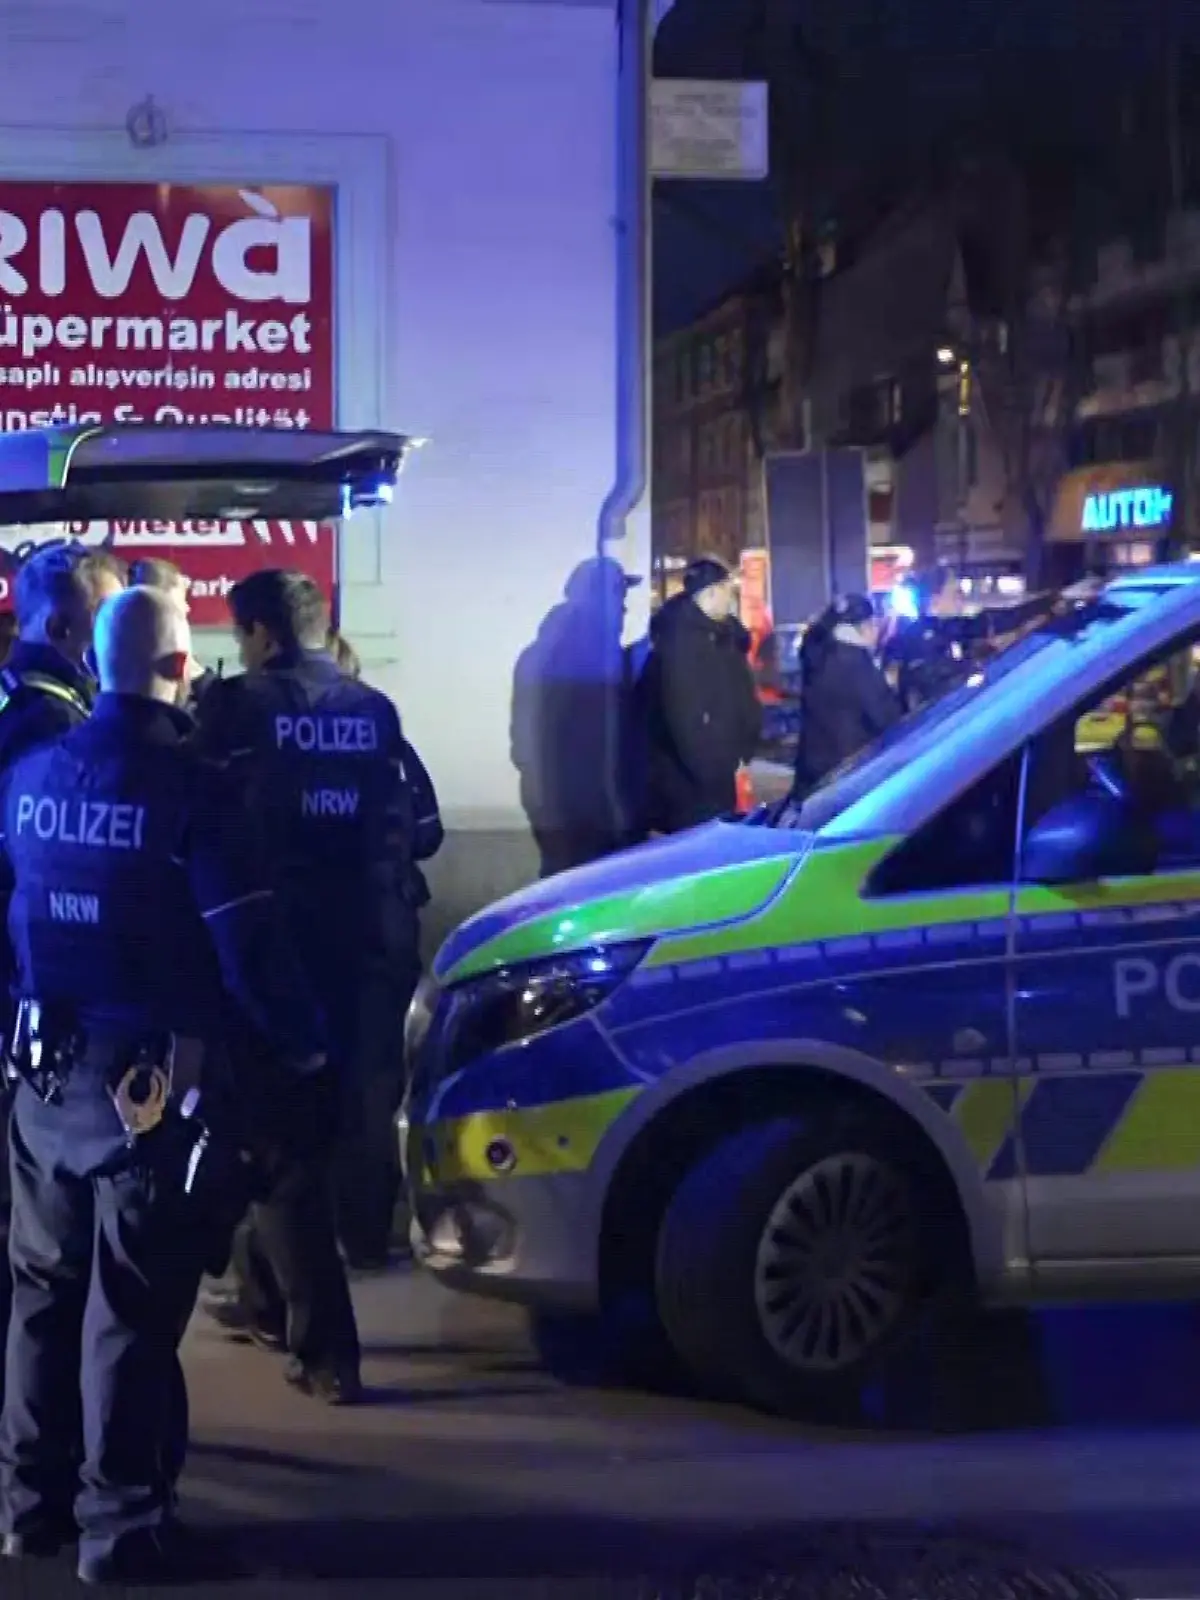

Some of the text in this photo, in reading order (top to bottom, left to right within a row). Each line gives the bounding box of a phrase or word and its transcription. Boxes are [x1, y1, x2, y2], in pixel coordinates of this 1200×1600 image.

[223, 367, 311, 390] adresi
[275, 714, 378, 751] POLIZEI
[300, 788, 361, 820] NRW
[16, 794, 145, 850] POLIZEI
[49, 891, 100, 925] NRW
